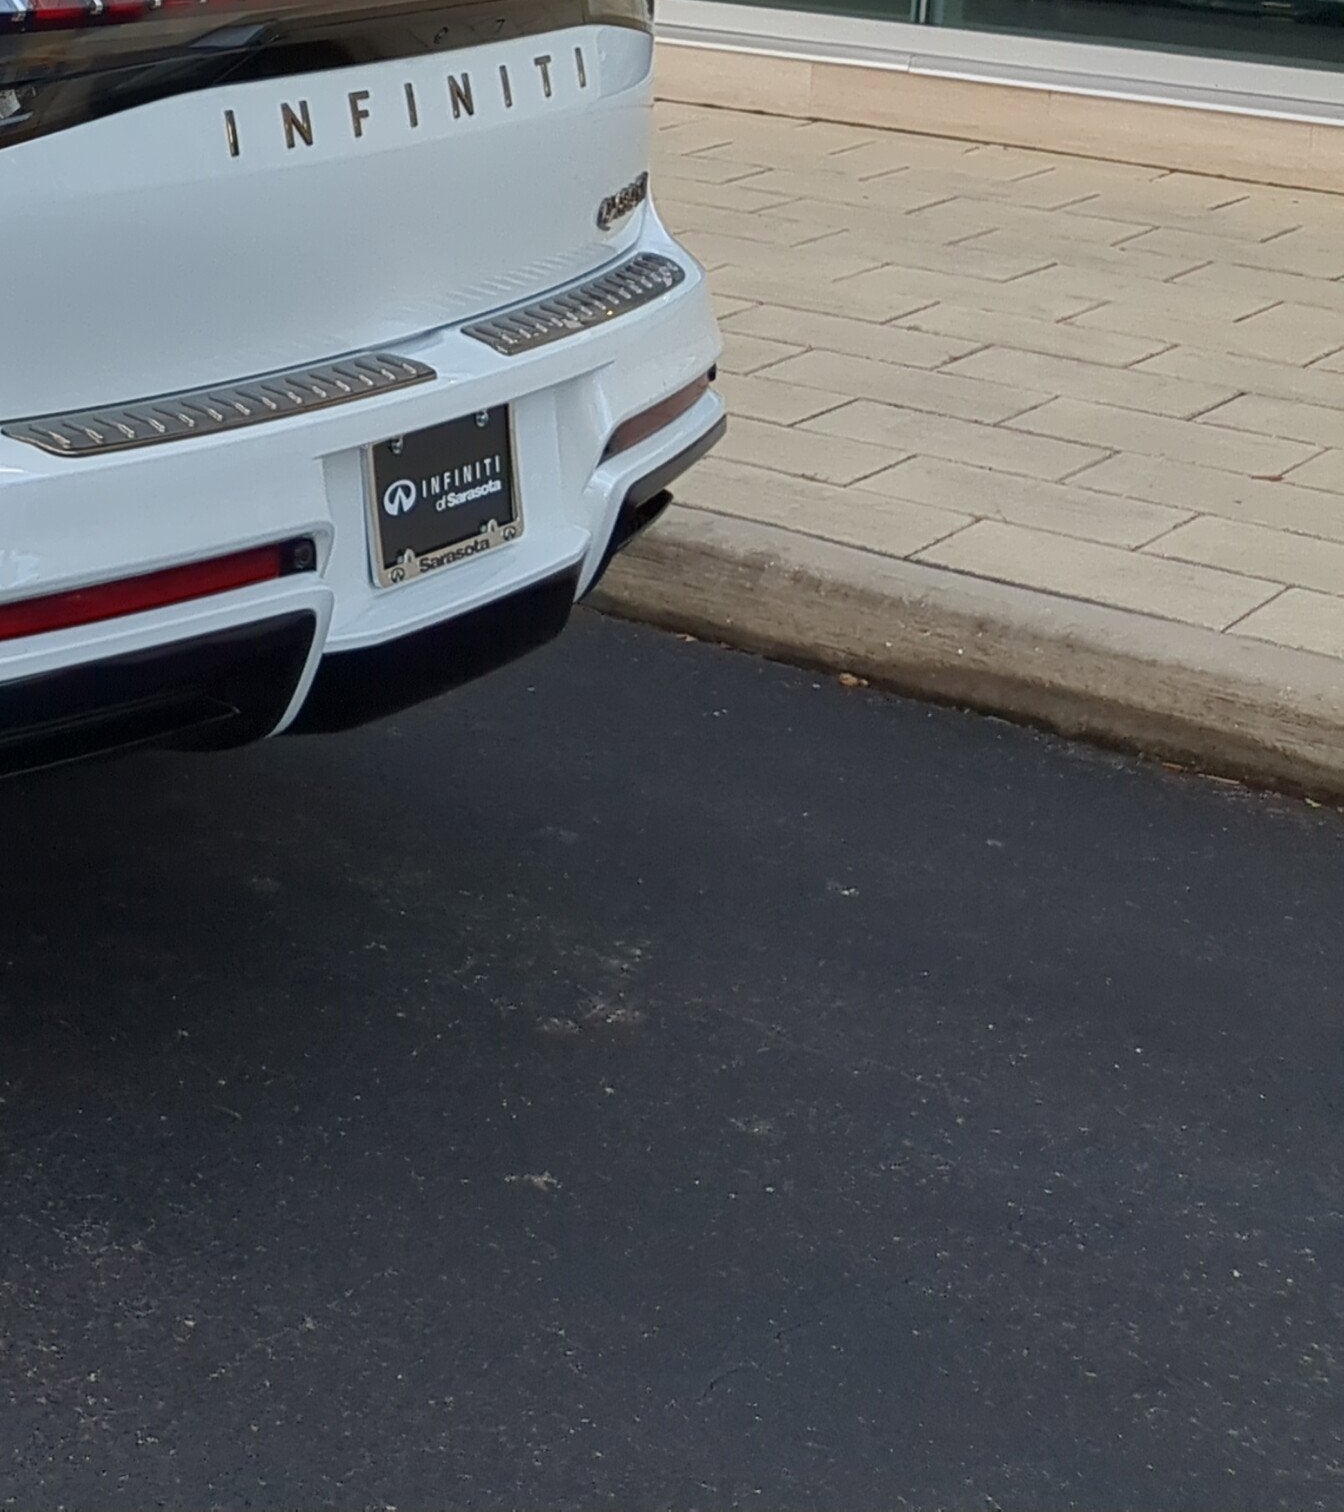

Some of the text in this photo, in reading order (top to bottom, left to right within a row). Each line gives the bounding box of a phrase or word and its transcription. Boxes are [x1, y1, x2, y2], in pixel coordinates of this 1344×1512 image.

[225, 47, 587, 157] INFINITI
[422, 455, 501, 498] INFINITI
[447, 480, 501, 507] Sarasota
[419, 539, 490, 573] Sarasota
